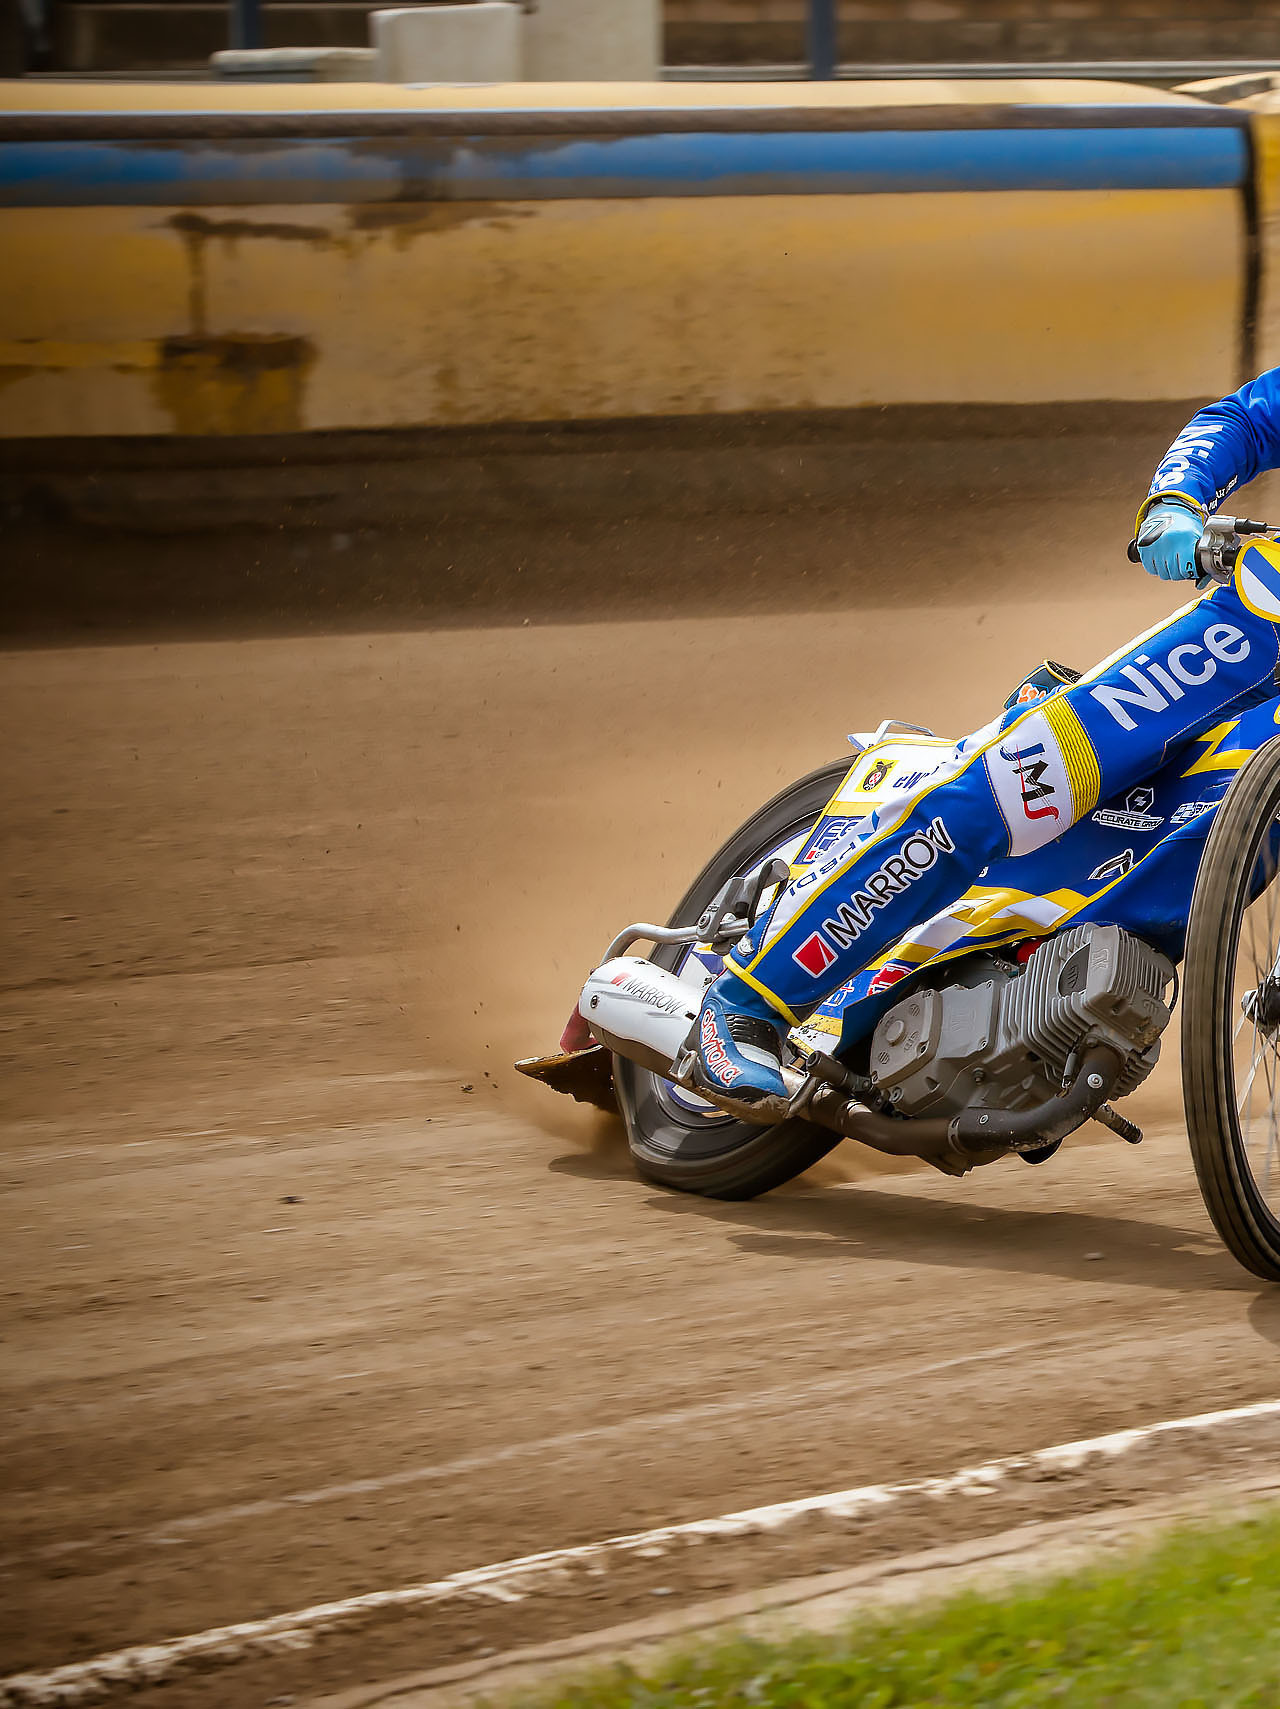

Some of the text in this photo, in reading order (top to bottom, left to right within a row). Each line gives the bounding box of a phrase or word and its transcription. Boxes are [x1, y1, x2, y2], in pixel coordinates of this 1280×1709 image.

[1089, 623, 1251, 732] Nice
[1093, 812, 1142, 827] ACCURATE
[622, 977, 686, 1015] MARROW
